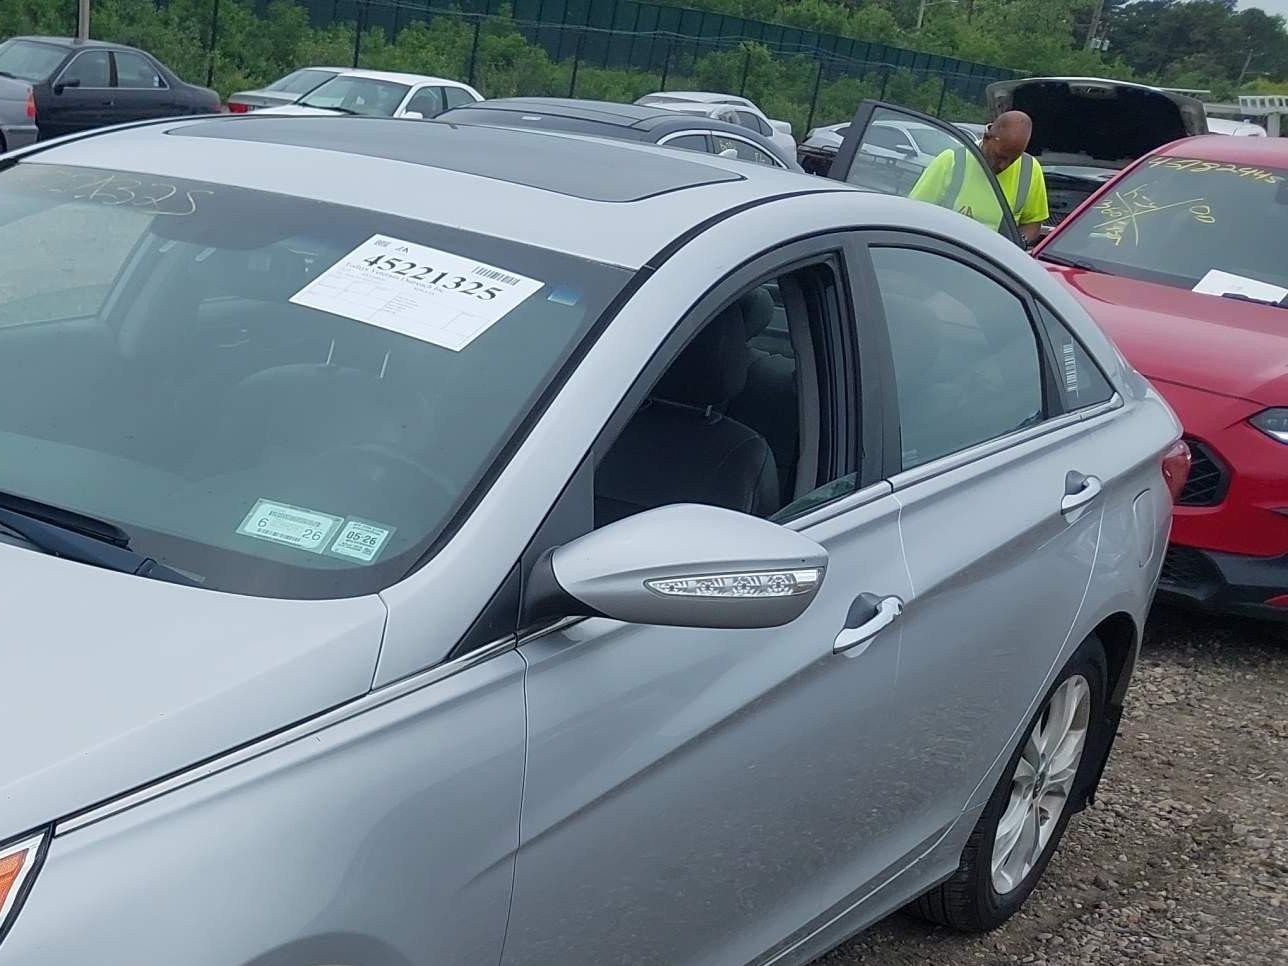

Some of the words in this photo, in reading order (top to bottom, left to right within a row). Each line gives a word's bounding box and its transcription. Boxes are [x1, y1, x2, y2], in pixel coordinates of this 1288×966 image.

[363, 253, 505, 301] 45221325
[257, 517, 270, 528] 6
[302, 527, 323, 541] 26
